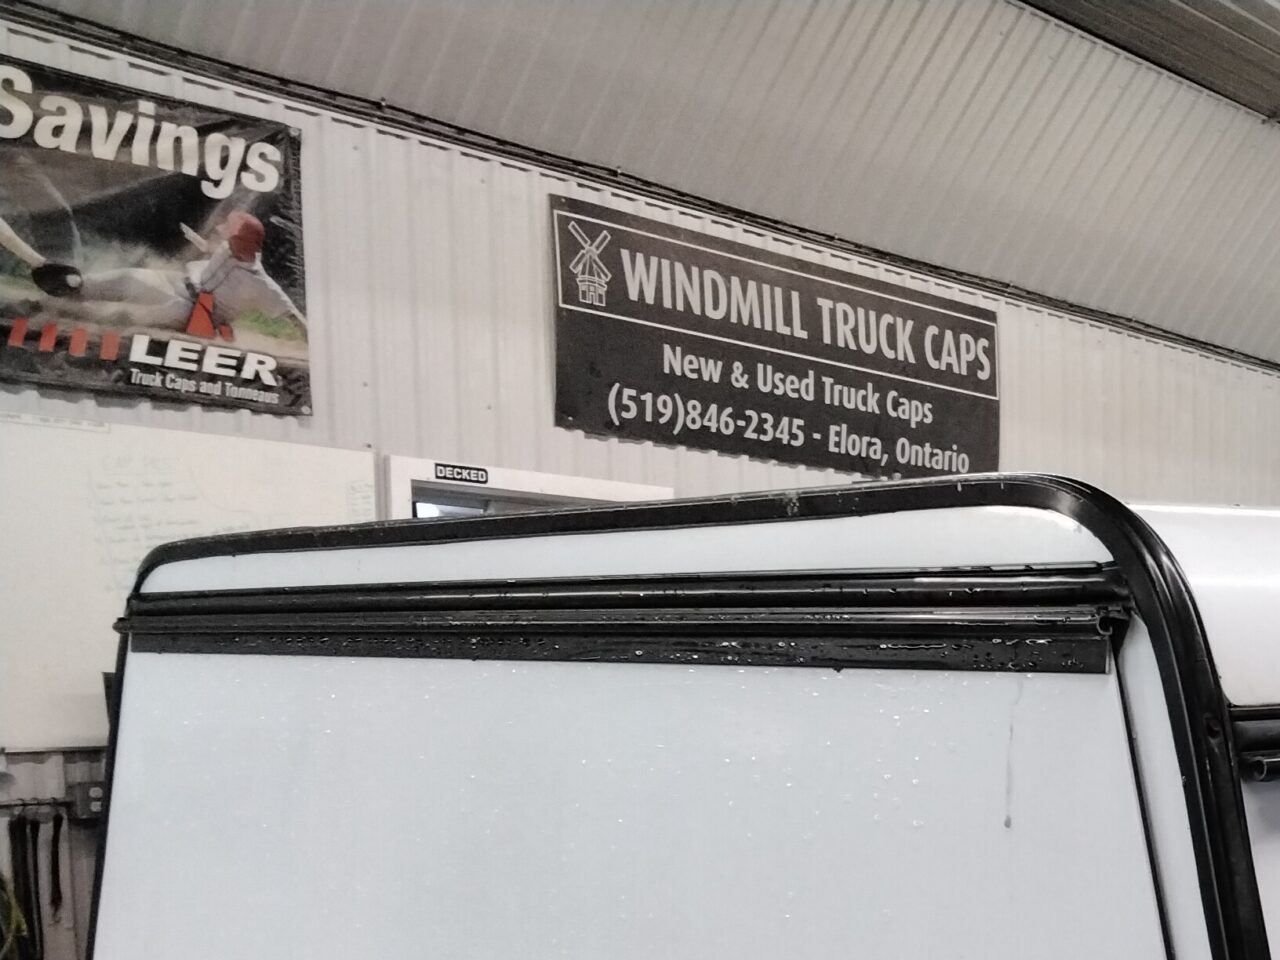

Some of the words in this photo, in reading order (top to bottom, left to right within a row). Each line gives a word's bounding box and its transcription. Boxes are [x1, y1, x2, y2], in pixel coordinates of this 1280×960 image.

[0, 65, 281, 200] Savings
[620, 248, 808, 339] WINDMILL
[817, 298, 916, 364] TRUCK
[924, 325, 991, 381] CAPS
[129, 333, 278, 387] LEER
[130, 368, 163, 388] Truck
[165, 373, 197, 393] Caps
[200, 381, 222, 396] and
[663, 344, 723, 383] New
[732, 361, 749, 389] &
[757, 363, 815, 402] Used
[822, 376, 880, 414] Truck
[887, 390, 933, 428] Caps
[608, 382, 805, 447] (519)846-2345
[828, 425, 888, 466] Elora,
[896, 438, 970, 474] Ontario
[436, 465, 487, 482] DECKED
